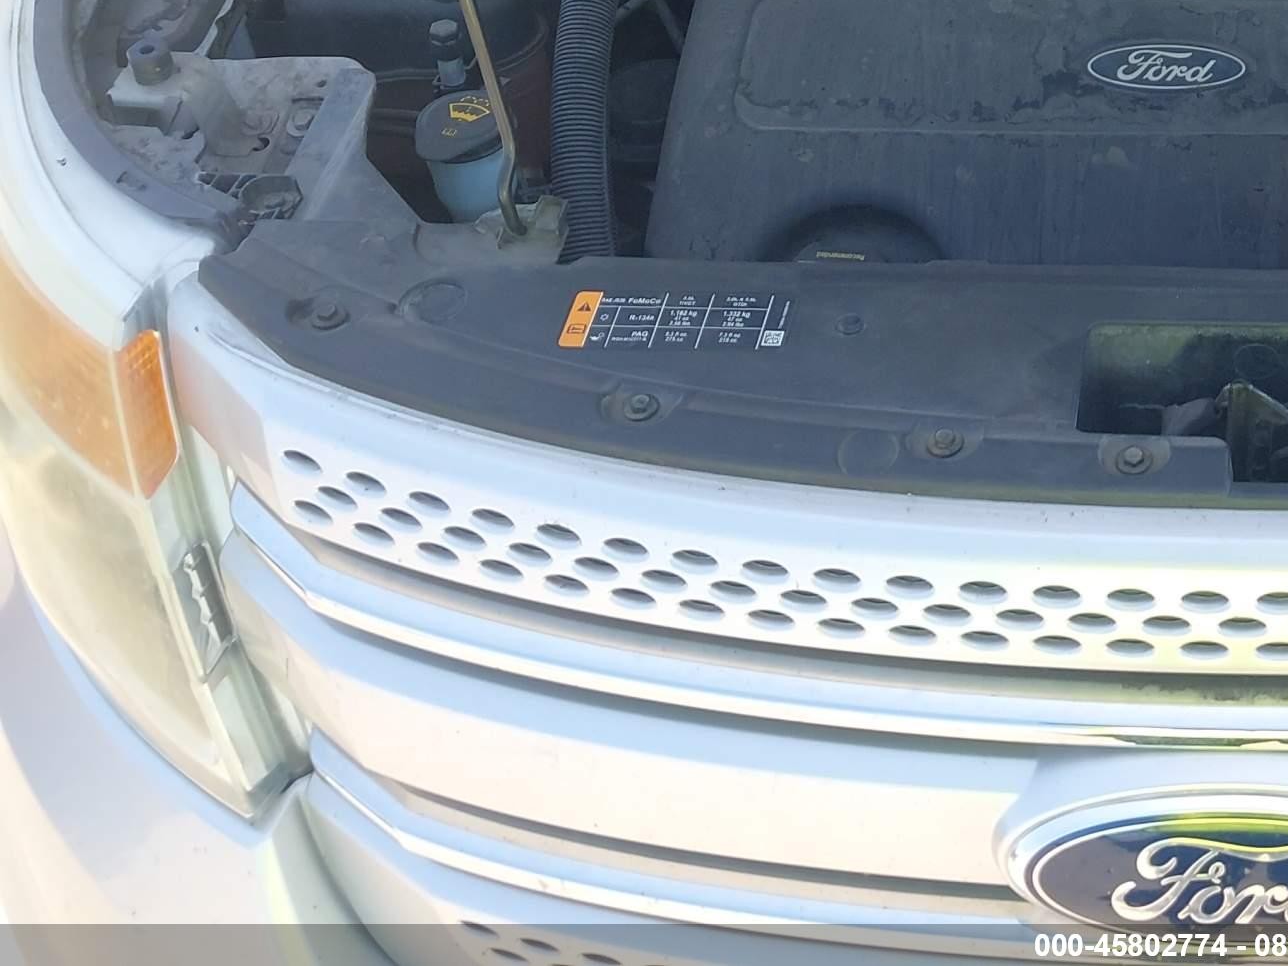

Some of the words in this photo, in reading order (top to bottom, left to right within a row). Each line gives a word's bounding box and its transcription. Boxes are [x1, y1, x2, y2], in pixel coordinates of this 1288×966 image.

[1116, 49, 1217, 83] Ford
[628, 297, 661, 305] FoMoCo
[629, 313, 655, 321] R-134a
[689, 310, 698, 318] kg
[742, 311, 751, 319] kg
